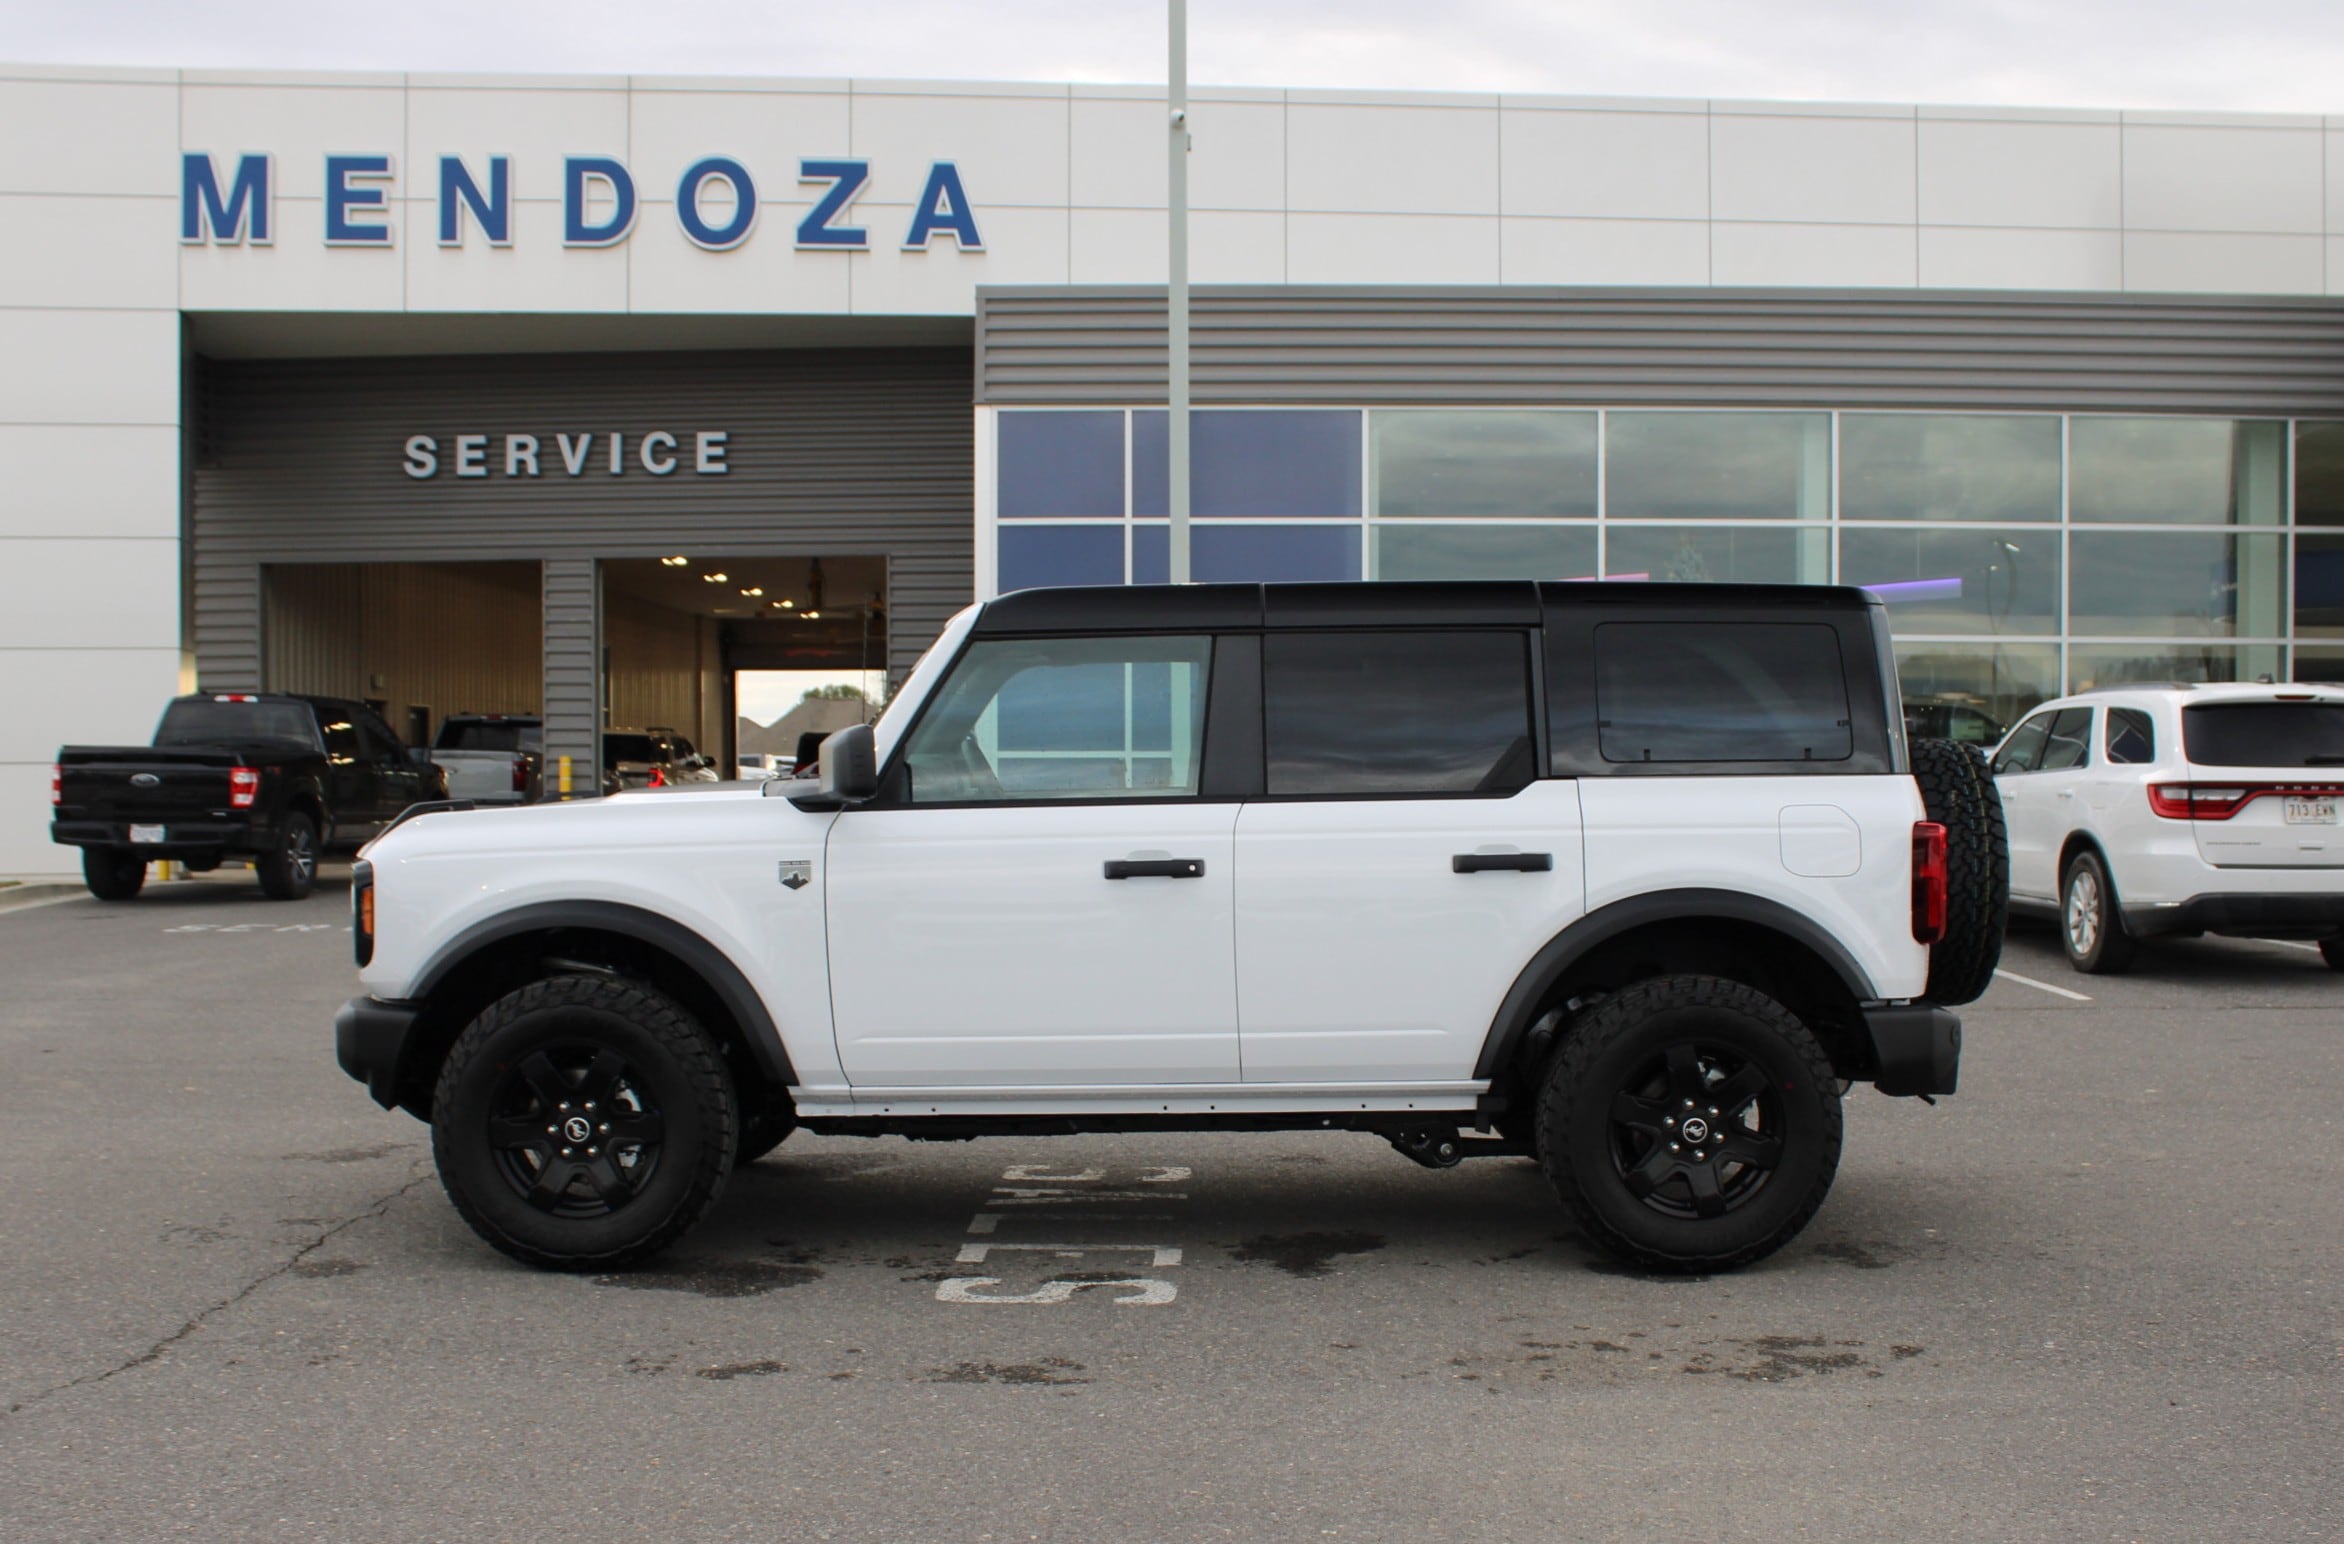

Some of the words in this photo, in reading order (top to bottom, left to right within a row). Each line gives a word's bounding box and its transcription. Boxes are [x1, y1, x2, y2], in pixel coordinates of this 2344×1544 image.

[180, 152, 986, 251] MENDOZA
[403, 430, 728, 478] SERVICE
[2288, 803, 2310, 817] 713
